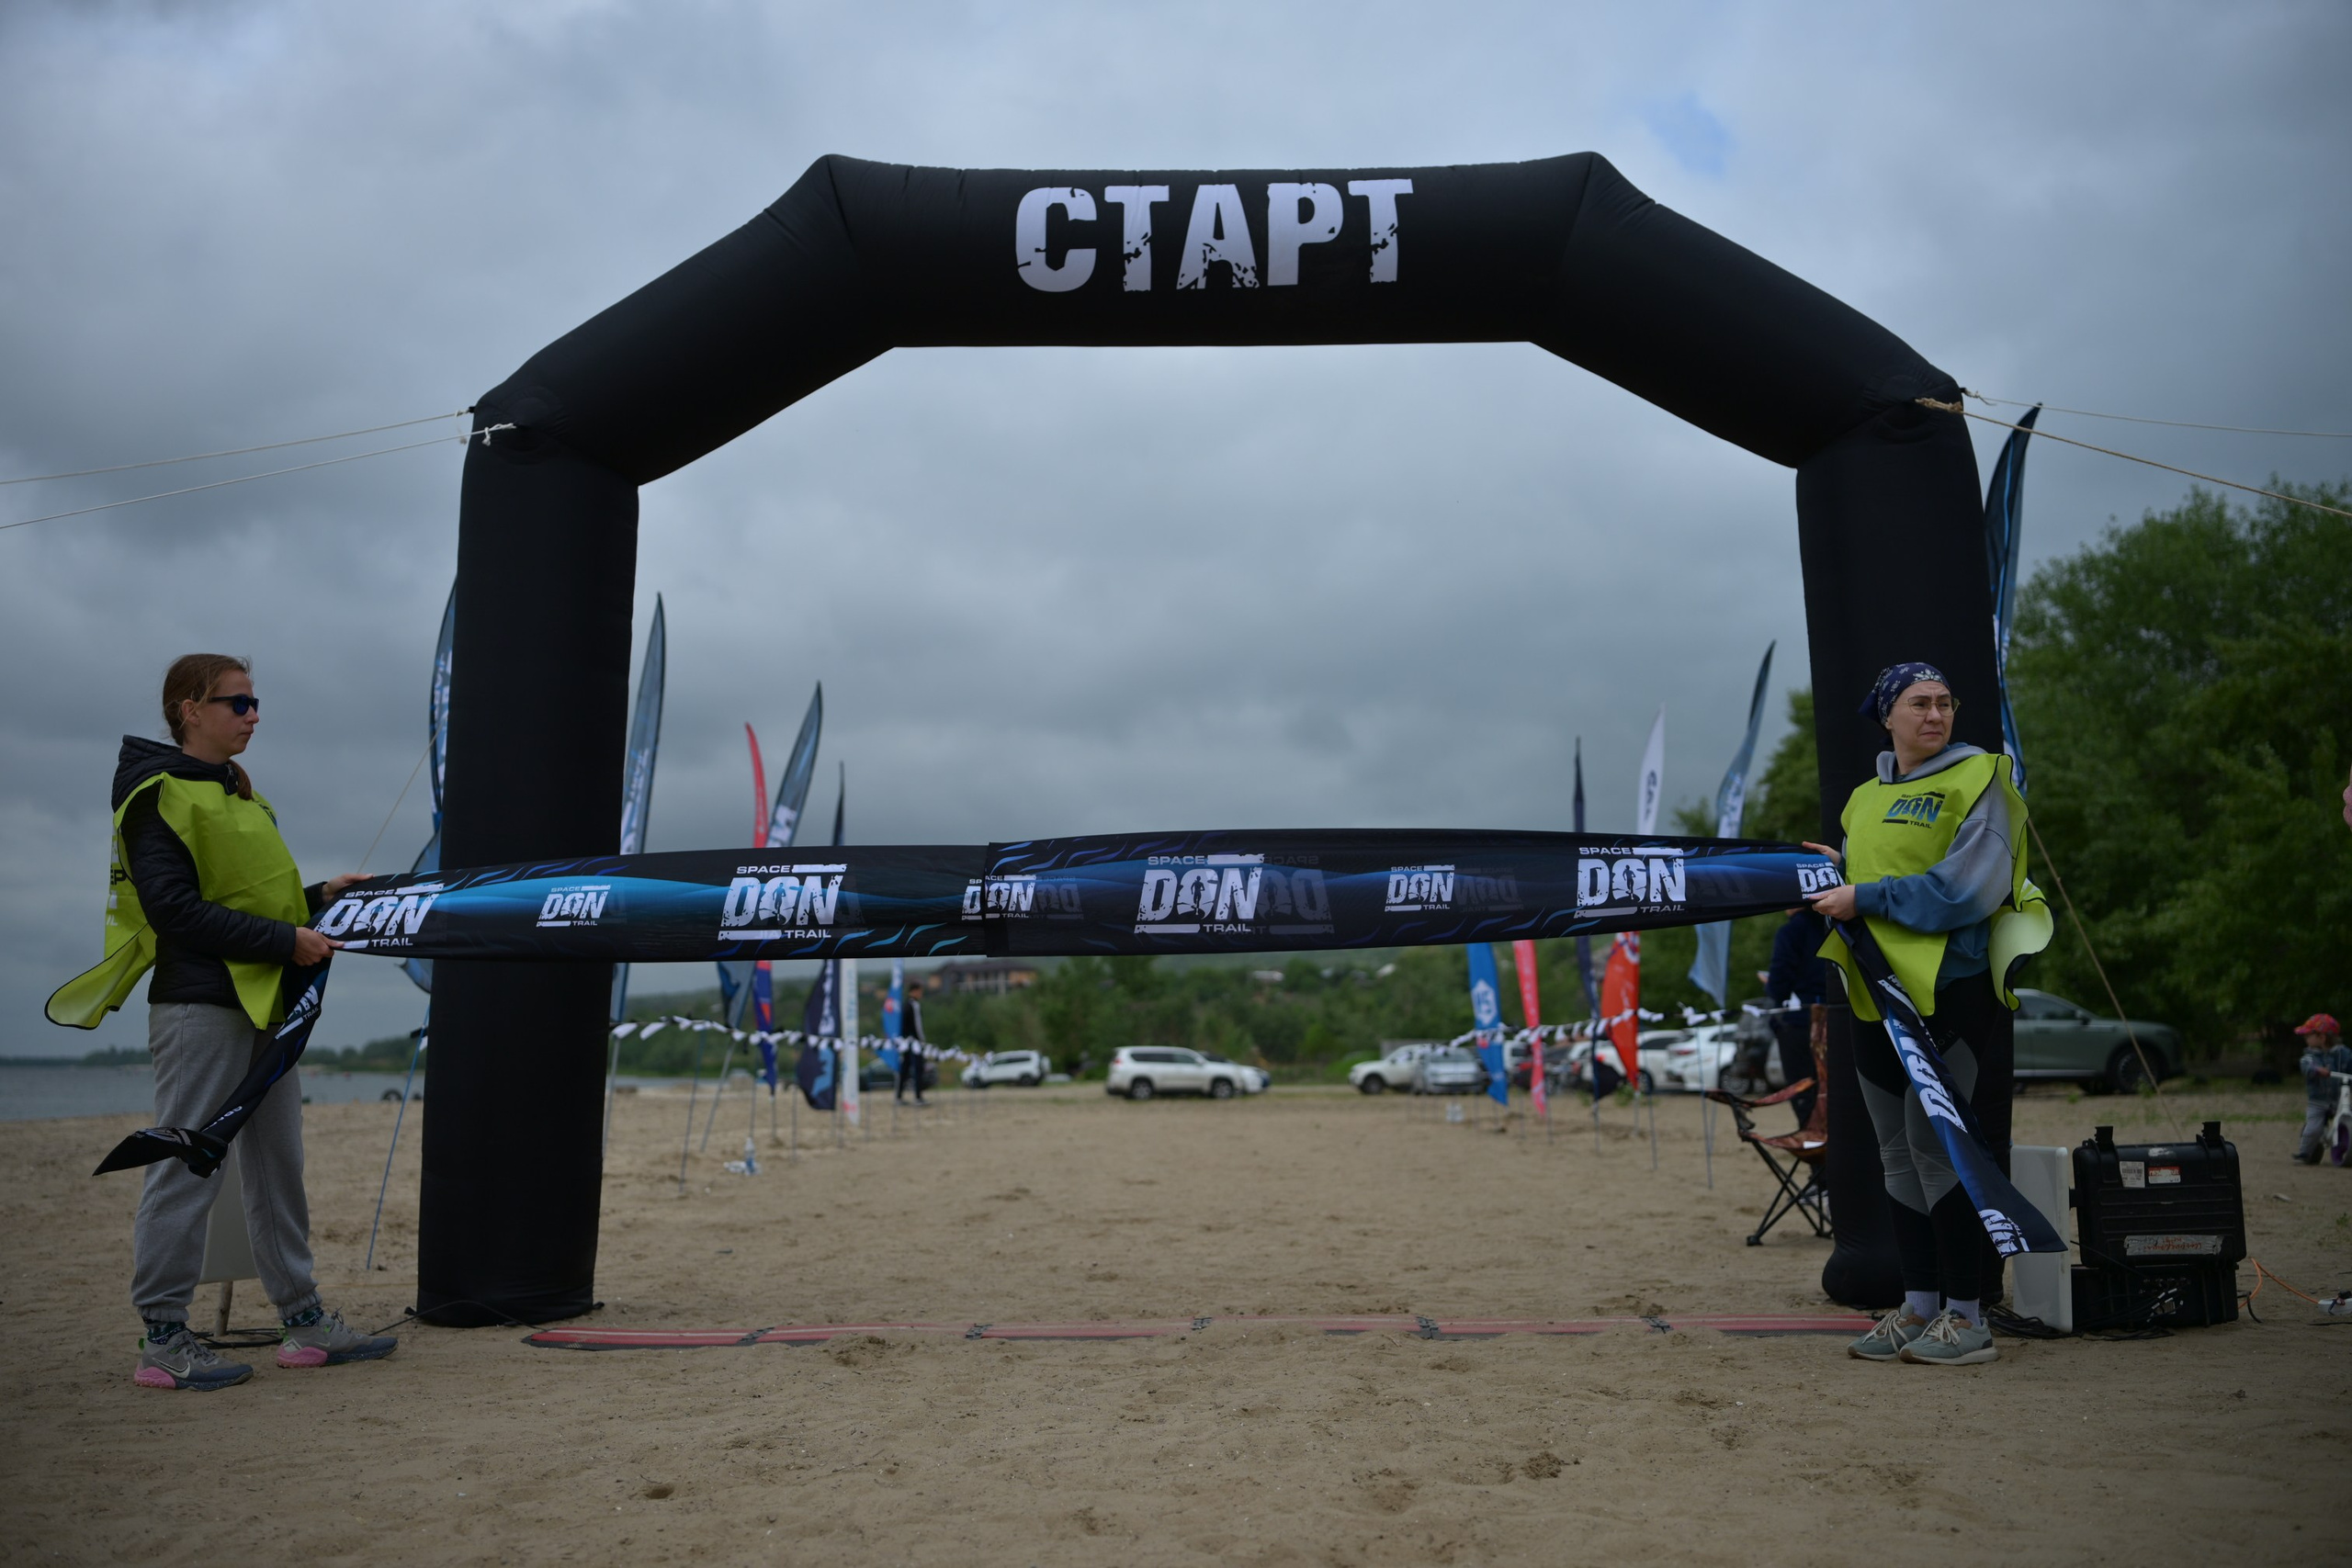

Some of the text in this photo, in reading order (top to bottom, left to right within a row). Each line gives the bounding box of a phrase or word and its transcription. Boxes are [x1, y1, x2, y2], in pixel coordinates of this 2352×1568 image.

[1015, 179, 1413, 292] СТАРТ
[1885, 796, 1944, 823] DON
[1909, 820, 1933, 829] TRAIL
[1148, 855, 1205, 865] SPACE
[1578, 847, 1633, 855] SPACE
[736, 865, 790, 874] SPACE
[1577, 858, 1687, 907] DON
[1797, 867, 1846, 893] DO
[345, 889, 396, 897] SPACE
[721, 875, 843, 927] DON
[962, 882, 1035, 914] DON
[1136, 866, 1262, 921] DON
[1385, 872, 1454, 905] DON
[313, 894, 439, 936] DON
[538, 891, 608, 920] DON
[1639, 905, 1685, 913] TRAIL
[784, 930, 831, 939] TRAIL
[1203, 923, 1251, 932] TRAIL
[371, 938, 413, 947] TRAIL
